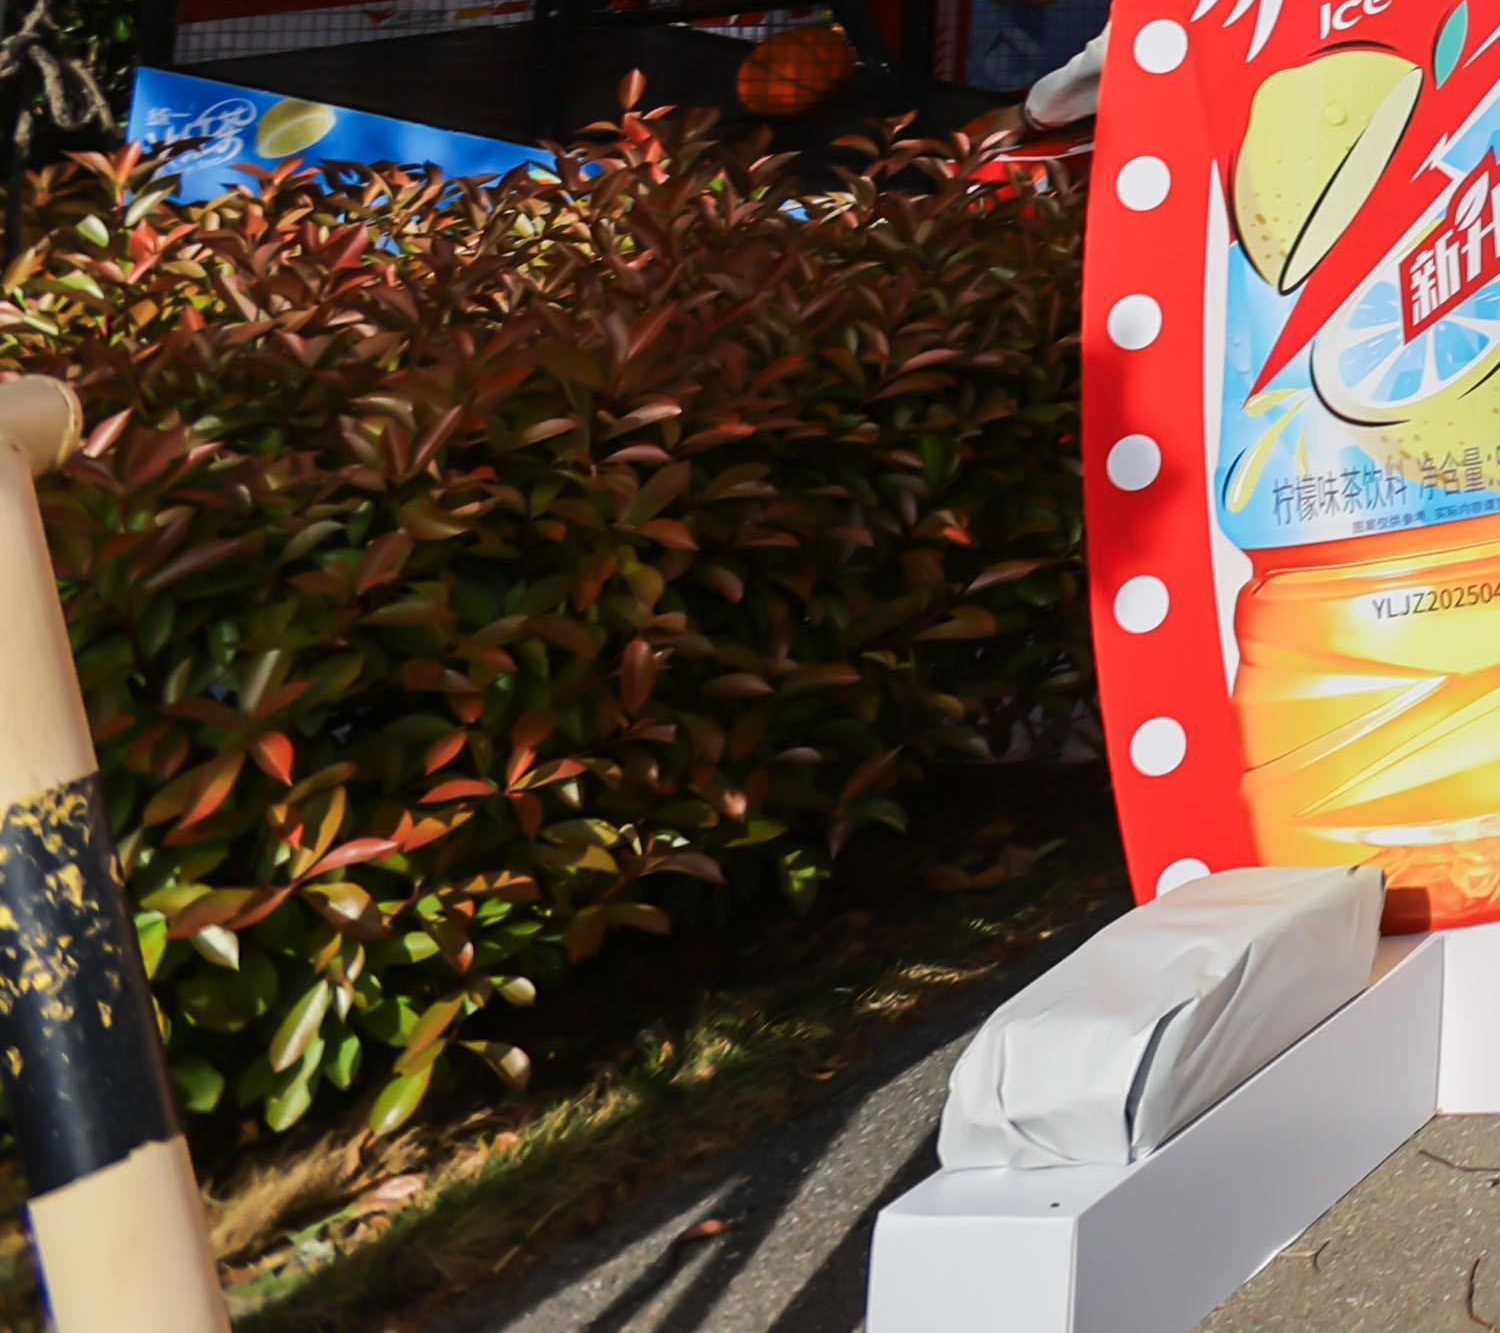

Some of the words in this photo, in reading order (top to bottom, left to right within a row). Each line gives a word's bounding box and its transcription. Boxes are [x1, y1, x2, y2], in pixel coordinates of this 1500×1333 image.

[1272, 458, 1408, 527] 柠檬味茶饮料
